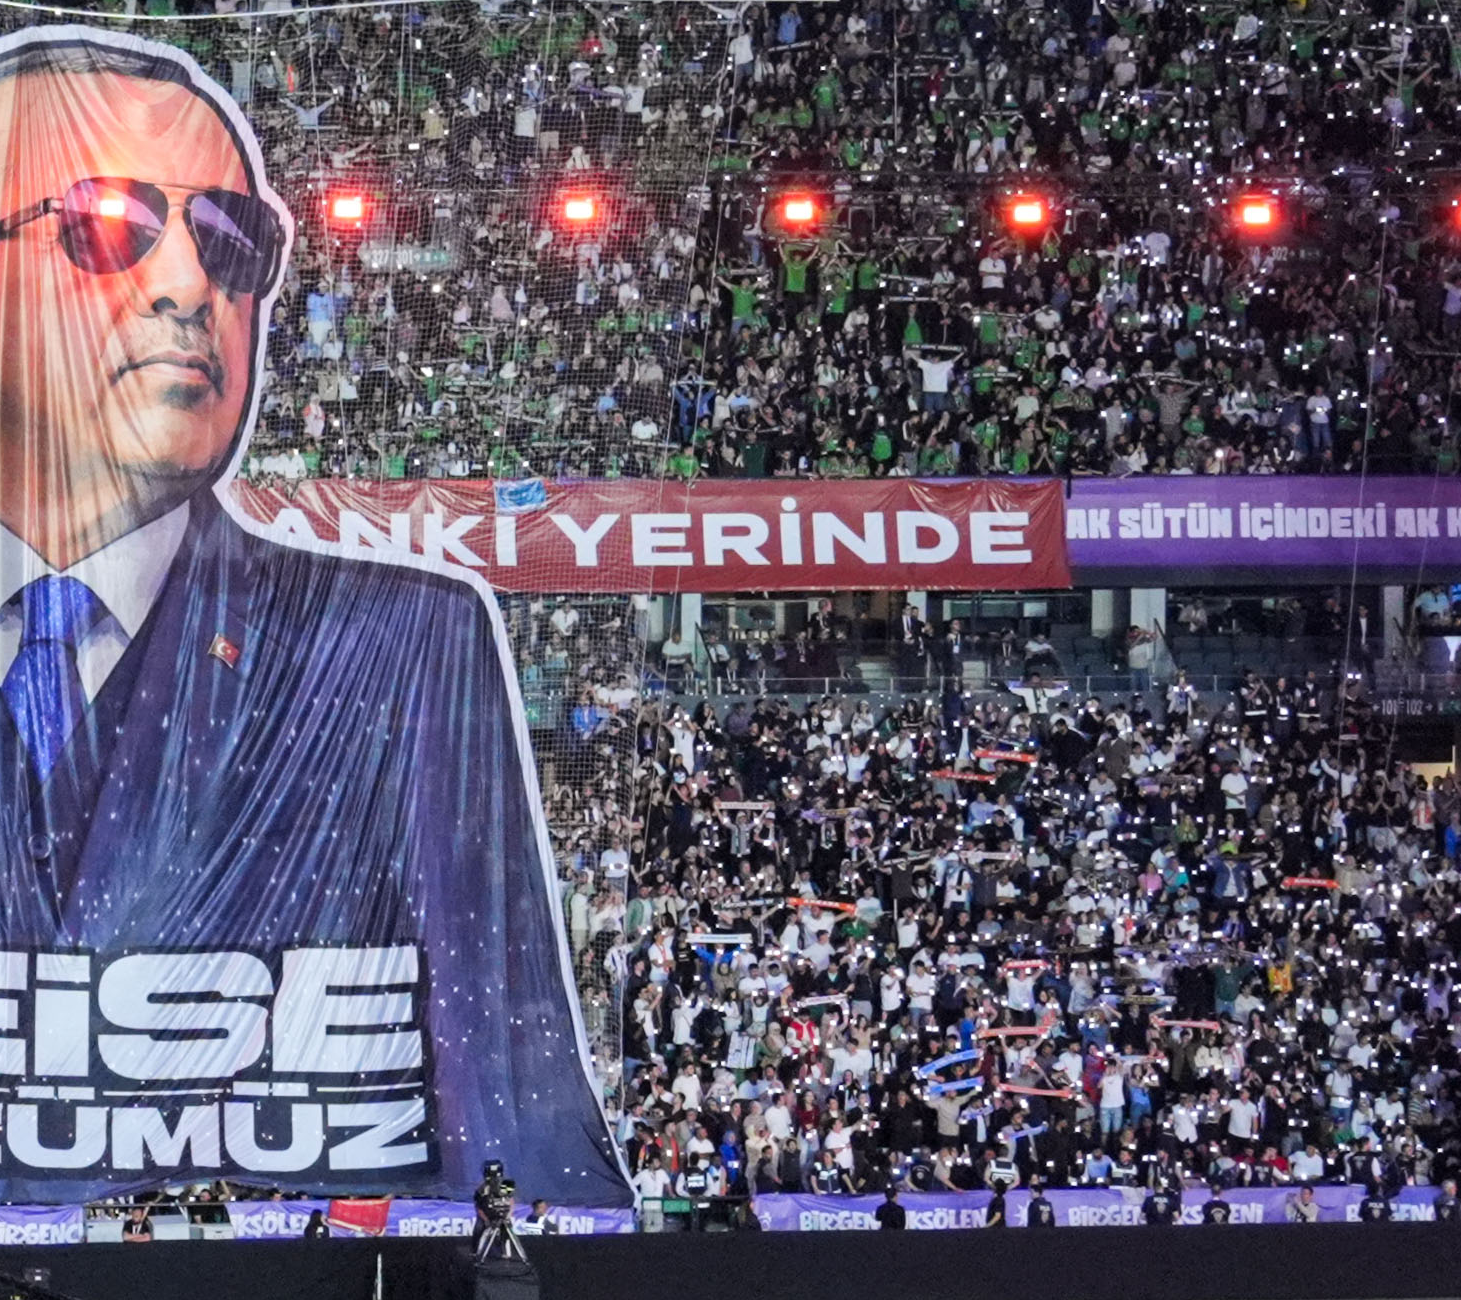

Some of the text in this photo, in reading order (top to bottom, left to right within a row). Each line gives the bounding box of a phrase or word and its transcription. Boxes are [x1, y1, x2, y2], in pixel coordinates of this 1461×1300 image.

[550, 496, 1033, 568] YERİNDE
[1118, 502, 1233, 539] SÜTÜN
[1240, 502, 1386, 542] İÇİNDEKİ
[1395, 507, 1440, 538] AK
